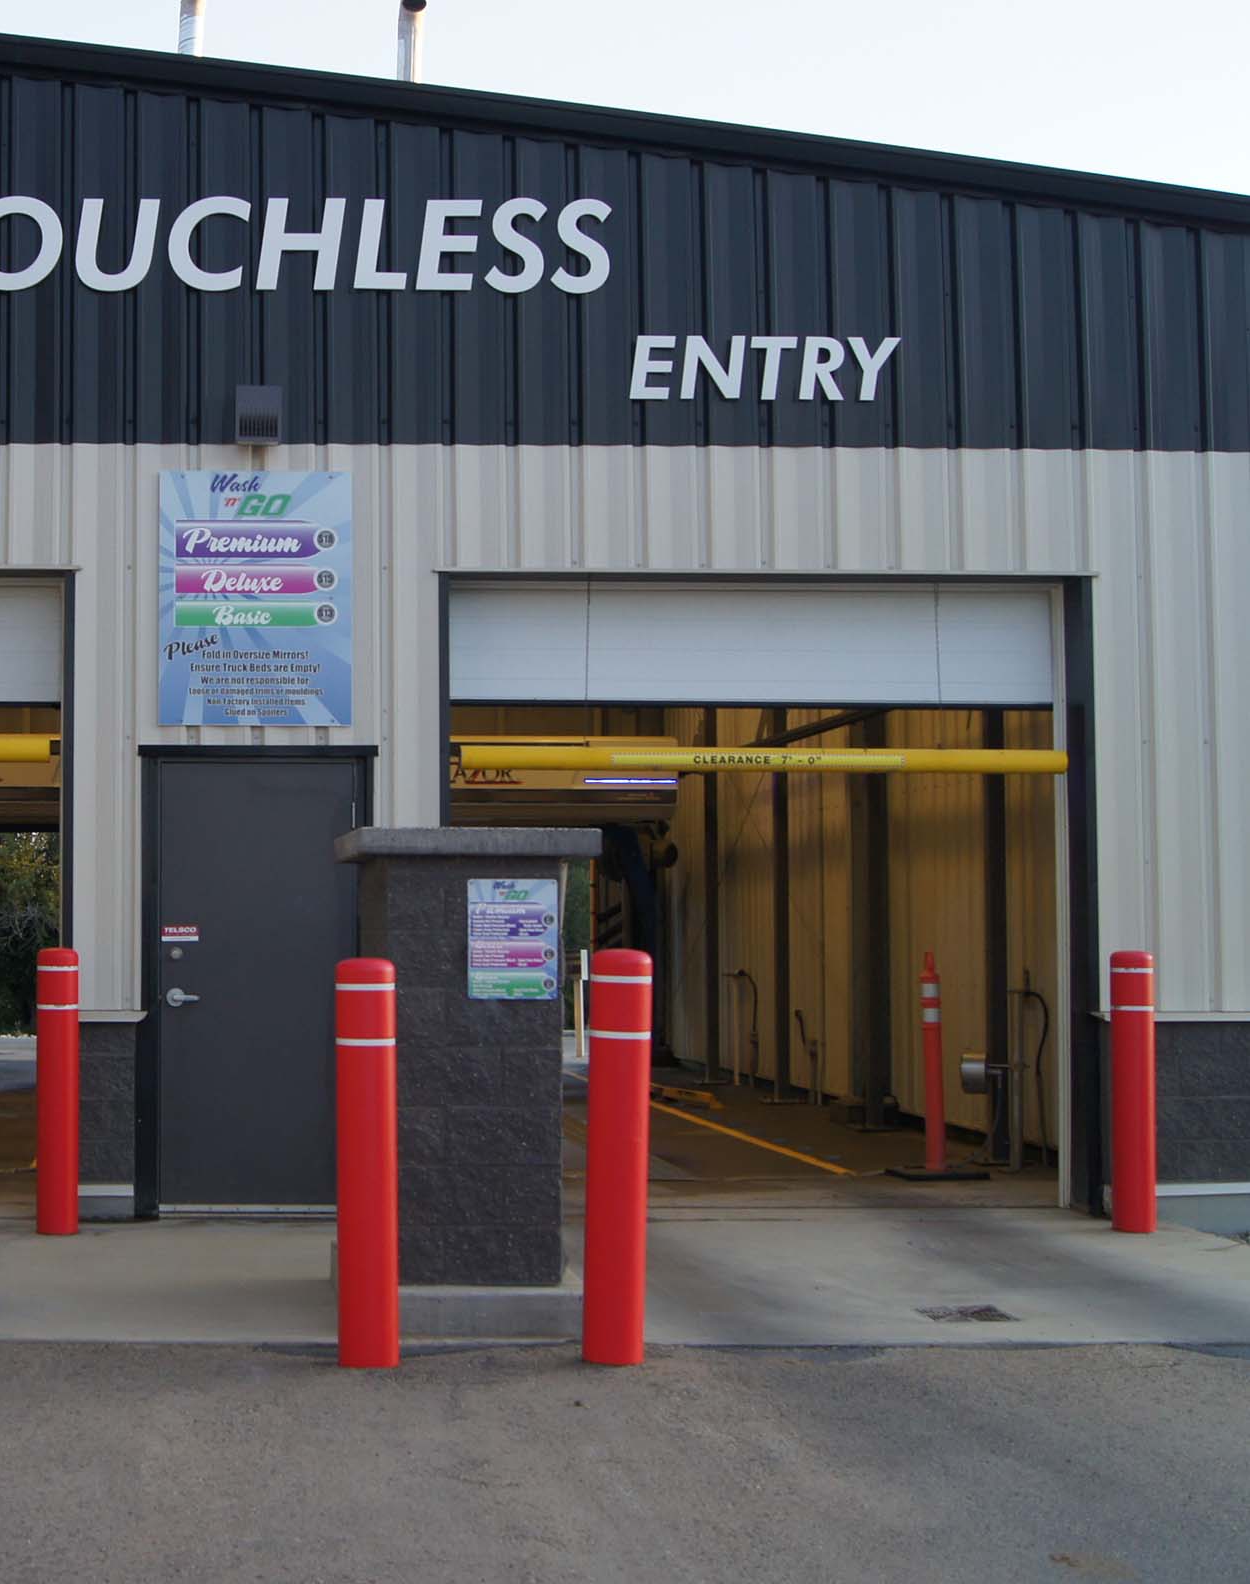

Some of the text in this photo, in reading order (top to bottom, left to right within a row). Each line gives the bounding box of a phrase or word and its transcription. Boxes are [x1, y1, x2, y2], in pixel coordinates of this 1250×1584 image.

[629, 335, 901, 400] ENTRY
[210, 473, 263, 493] Wash
[237, 493, 292, 517] GO
[182, 527, 301, 553] Premium
[201, 568, 284, 594] Deluxe
[212, 604, 272, 626] Basic
[163, 633, 219, 660] Please
[202, 650, 309, 659] Fold in Oversize Mirrors!
[190, 663, 320, 674] Ensure Truck Beds are Empty!
[201, 676, 309, 686] We are not responsible for
[221, 688, 254, 696] damaged
[693, 755, 771, 765] CLEARANCE
[450, 767, 526, 784] AZOR
